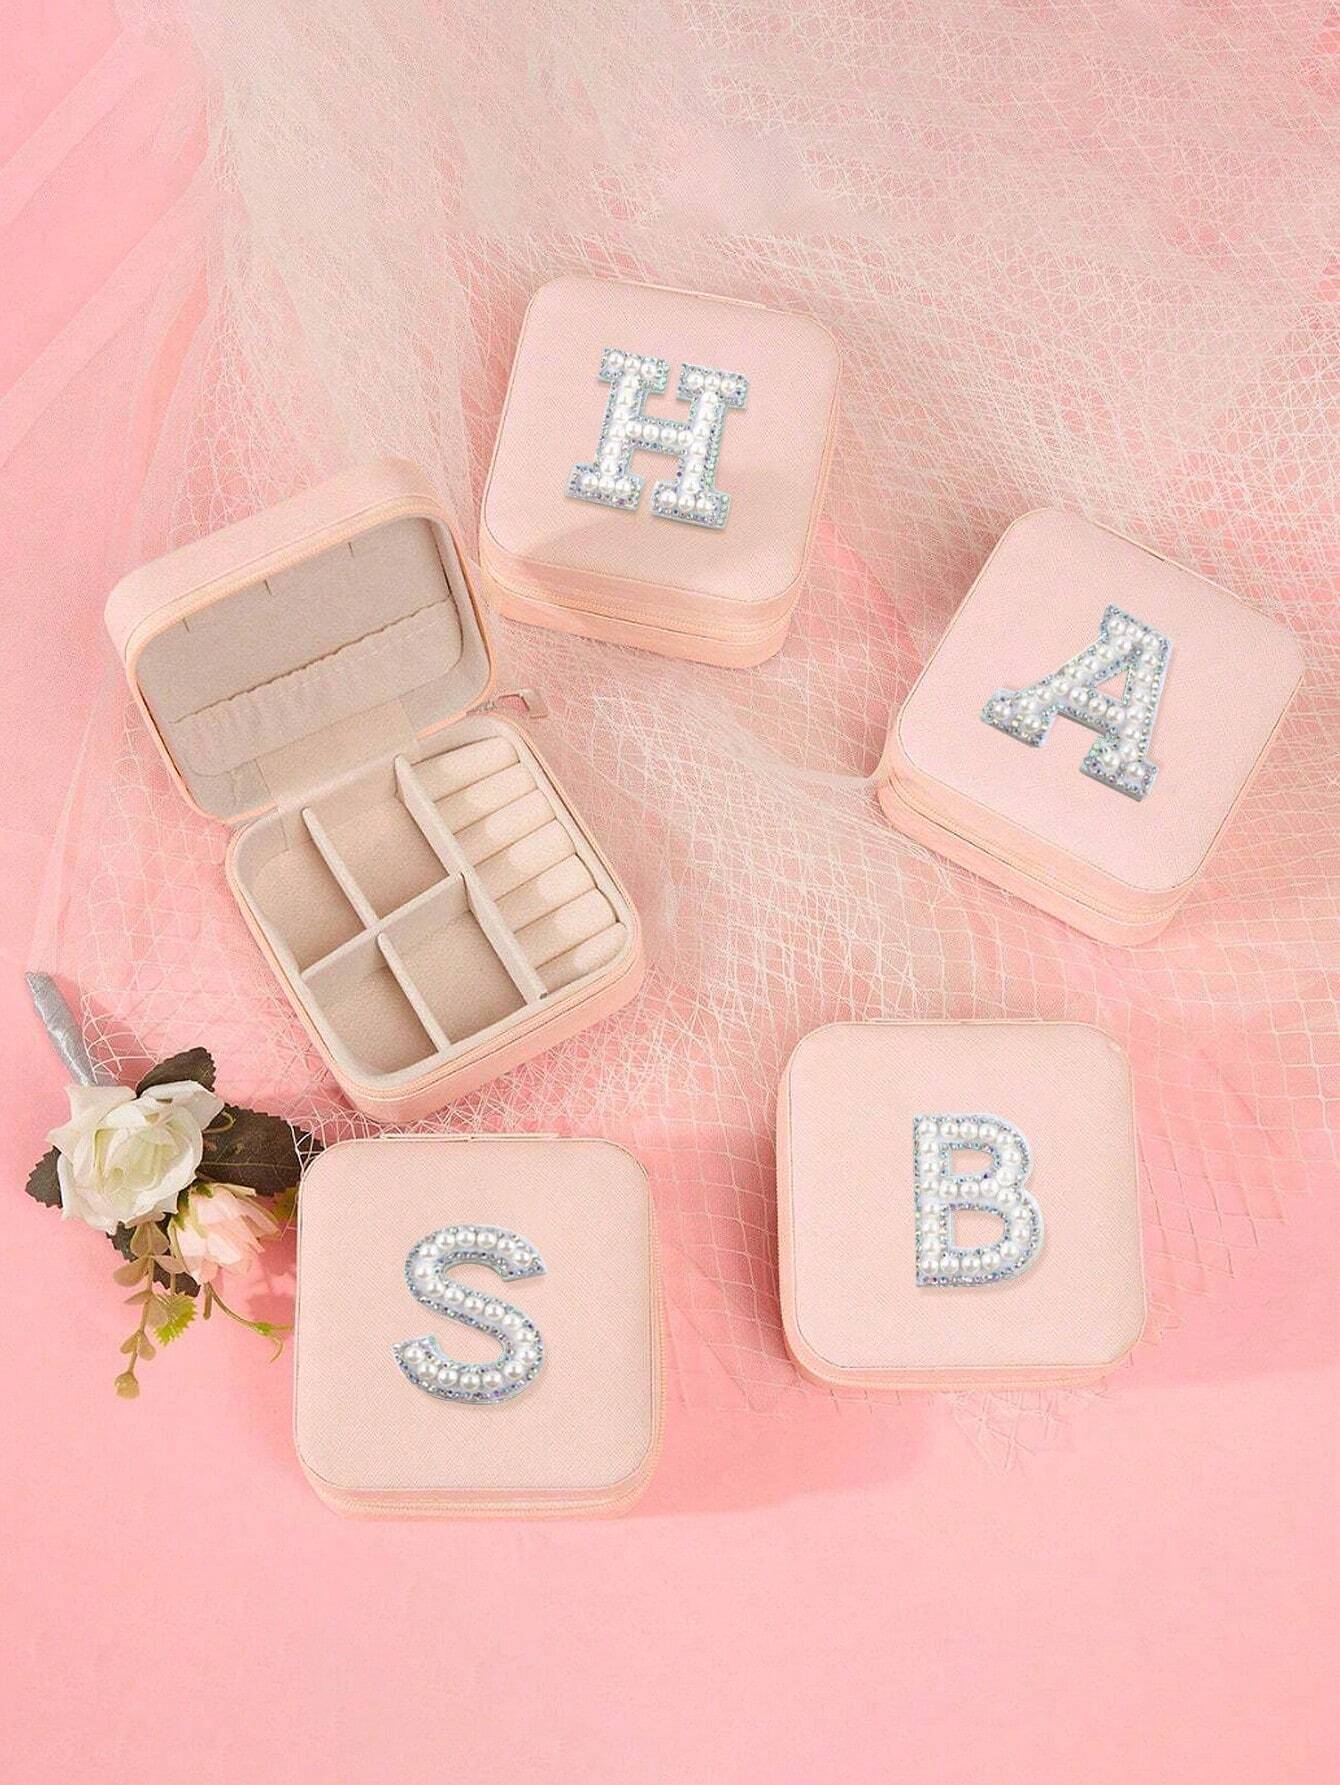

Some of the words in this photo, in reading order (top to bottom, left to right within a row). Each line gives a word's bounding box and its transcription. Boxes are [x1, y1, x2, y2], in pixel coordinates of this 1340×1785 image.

[565, 347, 748, 530] H
[980, 603, 1172, 803] A
[913, 1112, 1046, 1288] B
[392, 1224, 548, 1405] S
